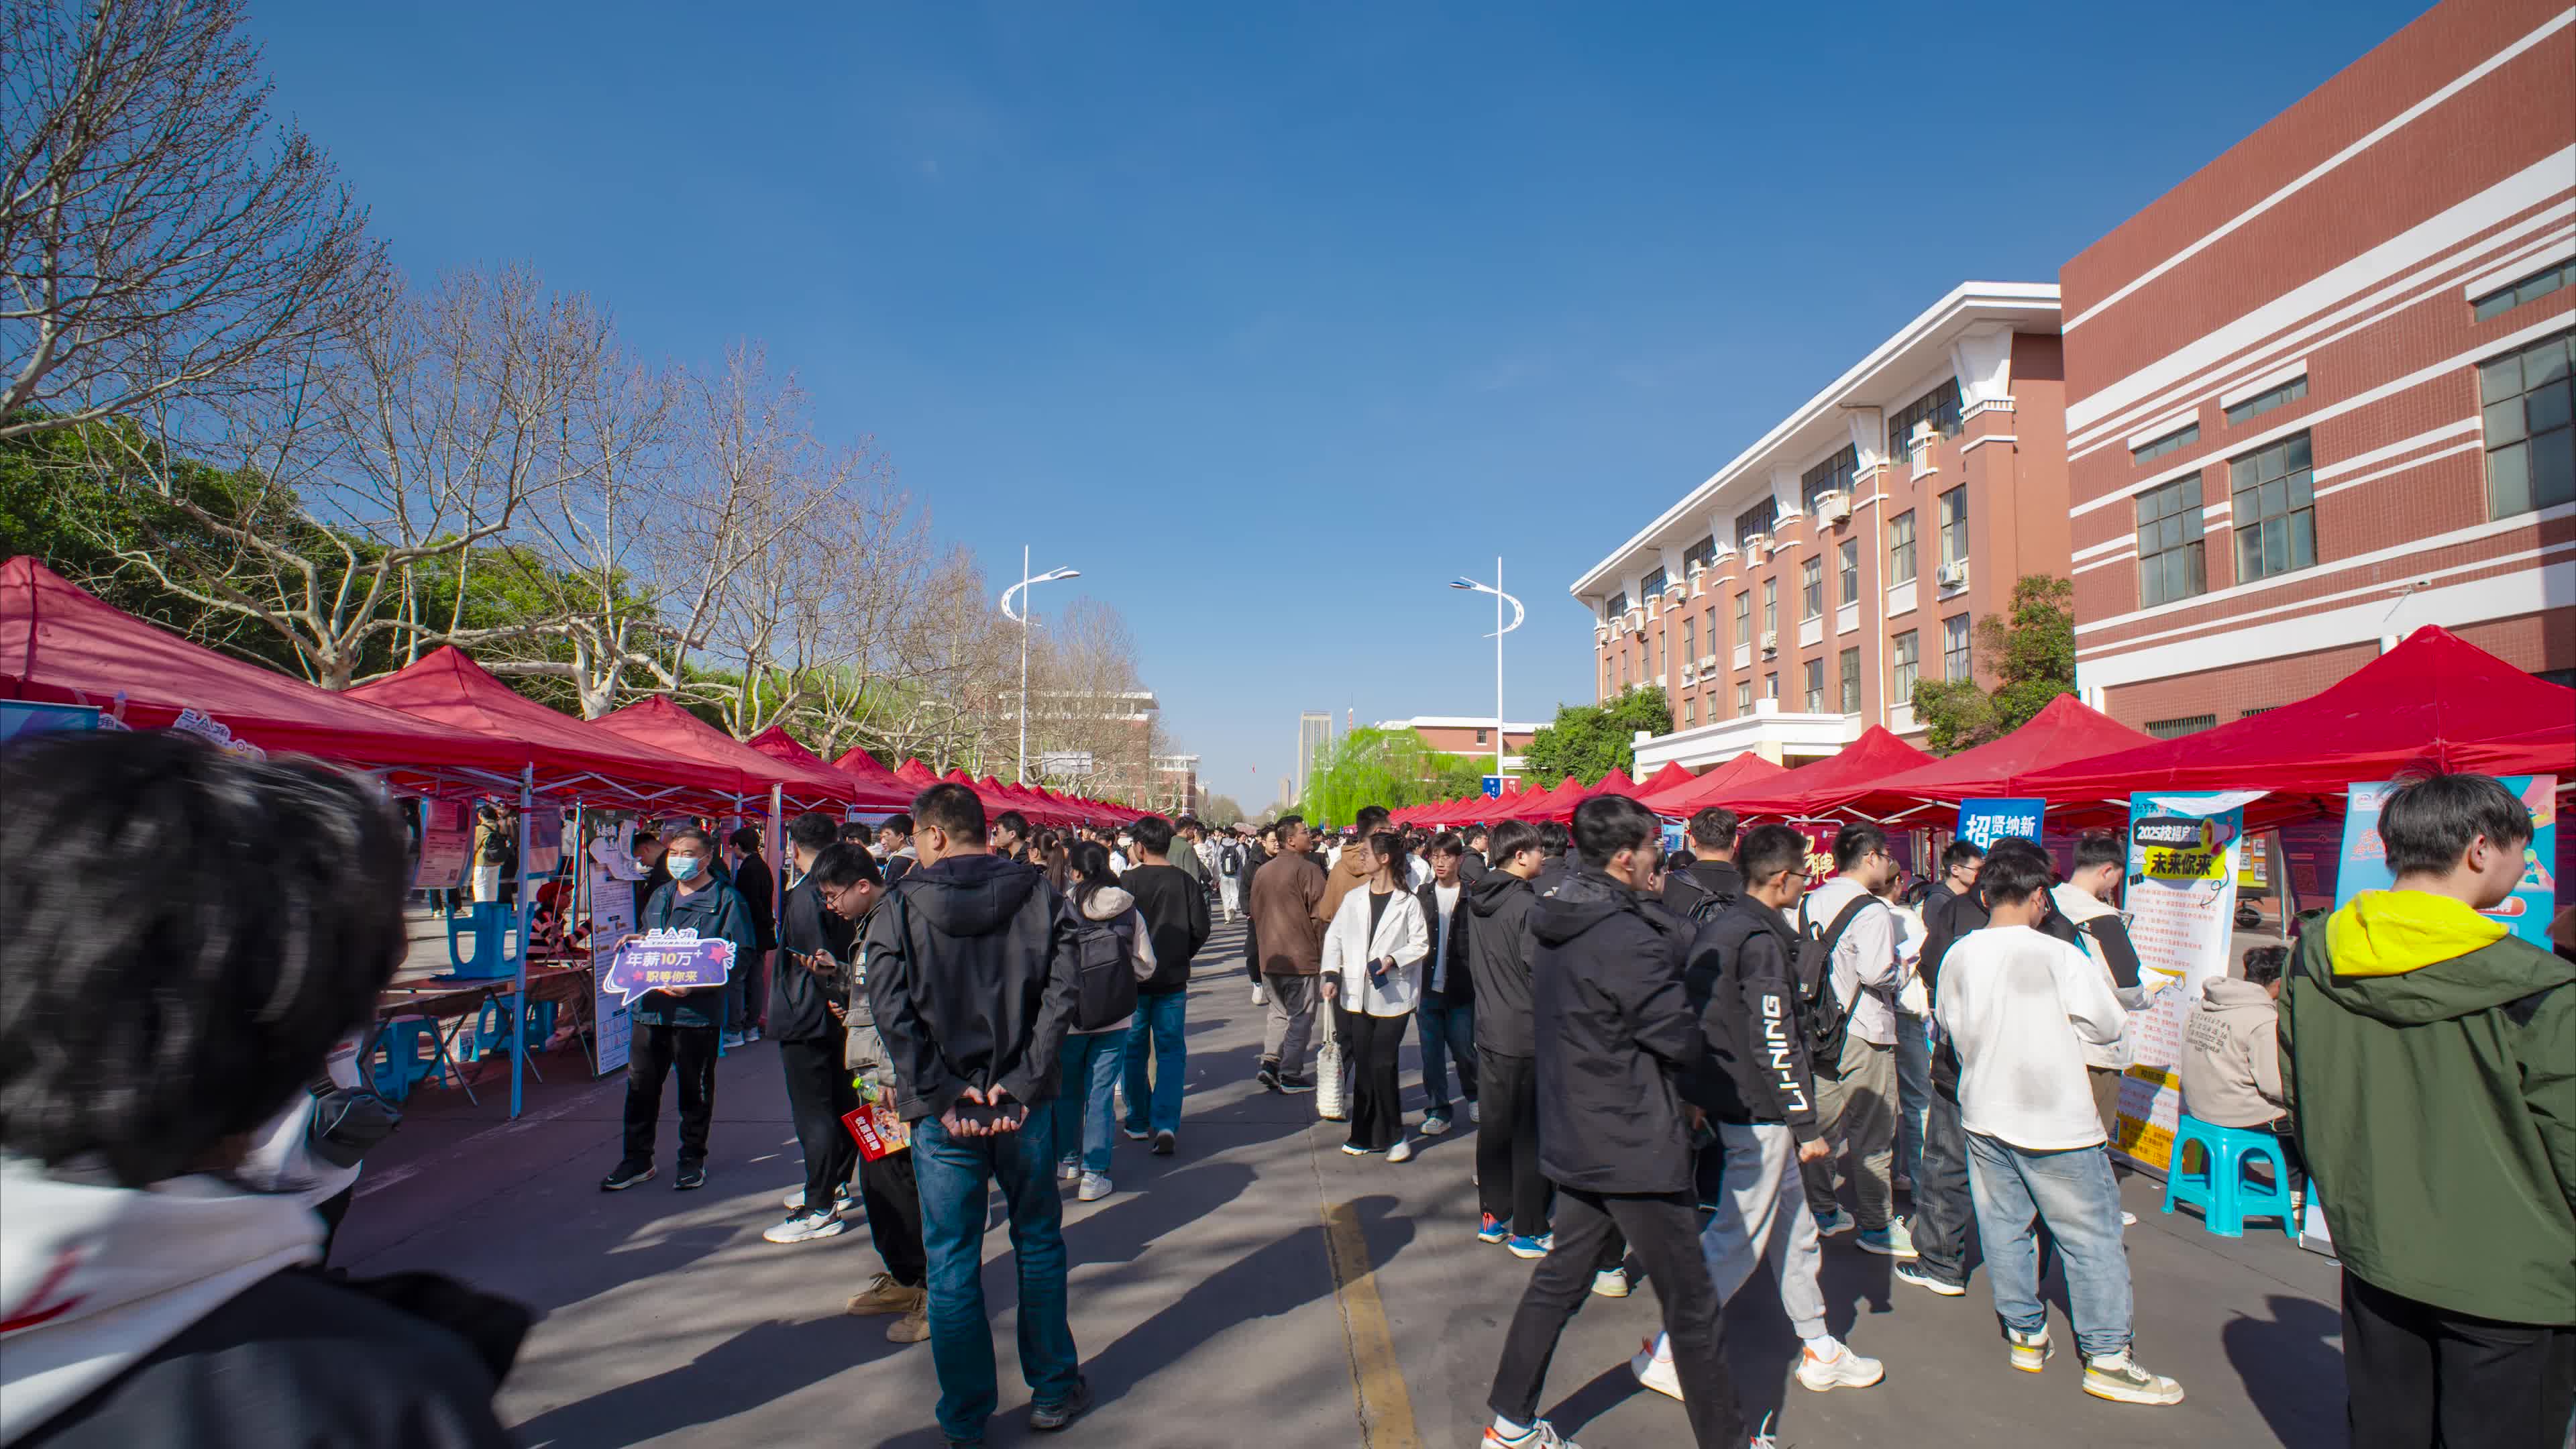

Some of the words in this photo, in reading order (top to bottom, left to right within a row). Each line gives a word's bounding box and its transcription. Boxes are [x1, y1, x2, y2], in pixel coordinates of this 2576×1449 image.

[1965, 814, 2036, 848] 招贤纳新
[2151, 852, 2212, 875] 未来你来
[626, 950, 704, 967] 年薪10万+
[646, 971, 698, 983] 职等你来
[1762, 994, 1809, 1111] LI-NING
